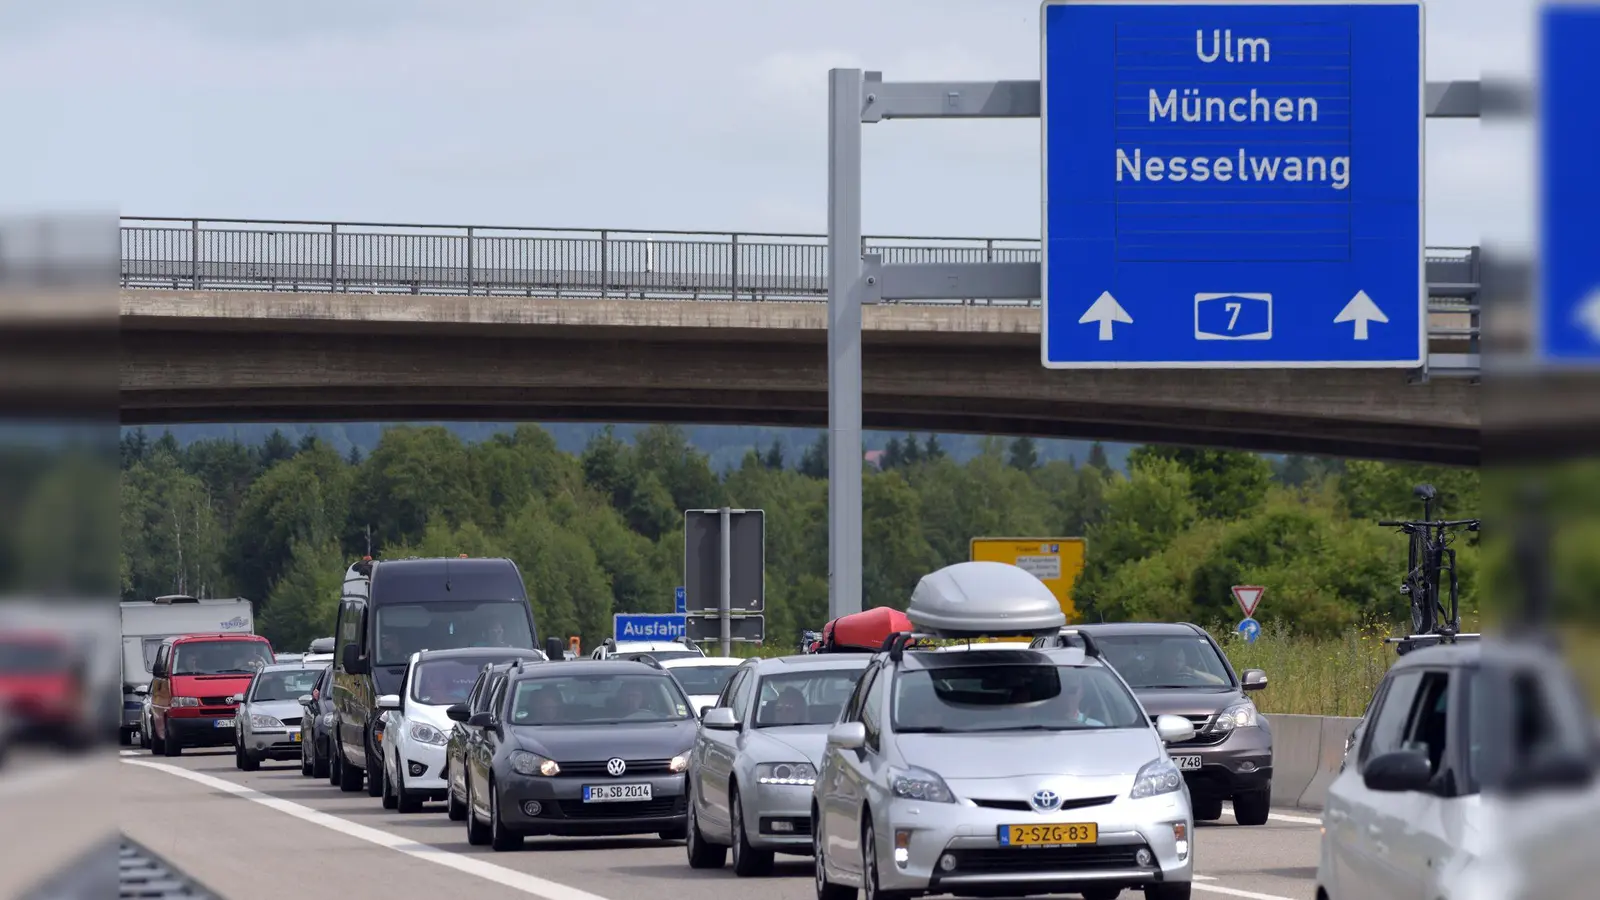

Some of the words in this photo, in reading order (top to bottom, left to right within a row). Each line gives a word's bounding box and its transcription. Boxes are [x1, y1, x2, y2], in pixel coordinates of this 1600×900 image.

[1197, 30, 1269, 62] Ulm
[1150, 89, 1317, 121] München
[1117, 149, 1349, 189] Nesselwang
[1226, 303, 1240, 329] 7
[624, 621, 685, 635] Ausfahr
[1180, 757, 1200, 767] 748
[590, 787, 603, 798] FB
[610, 786, 622, 797] SB
[624, 785, 649, 796] 2014
[1015, 826, 1088, 842] 2-SZG-83
